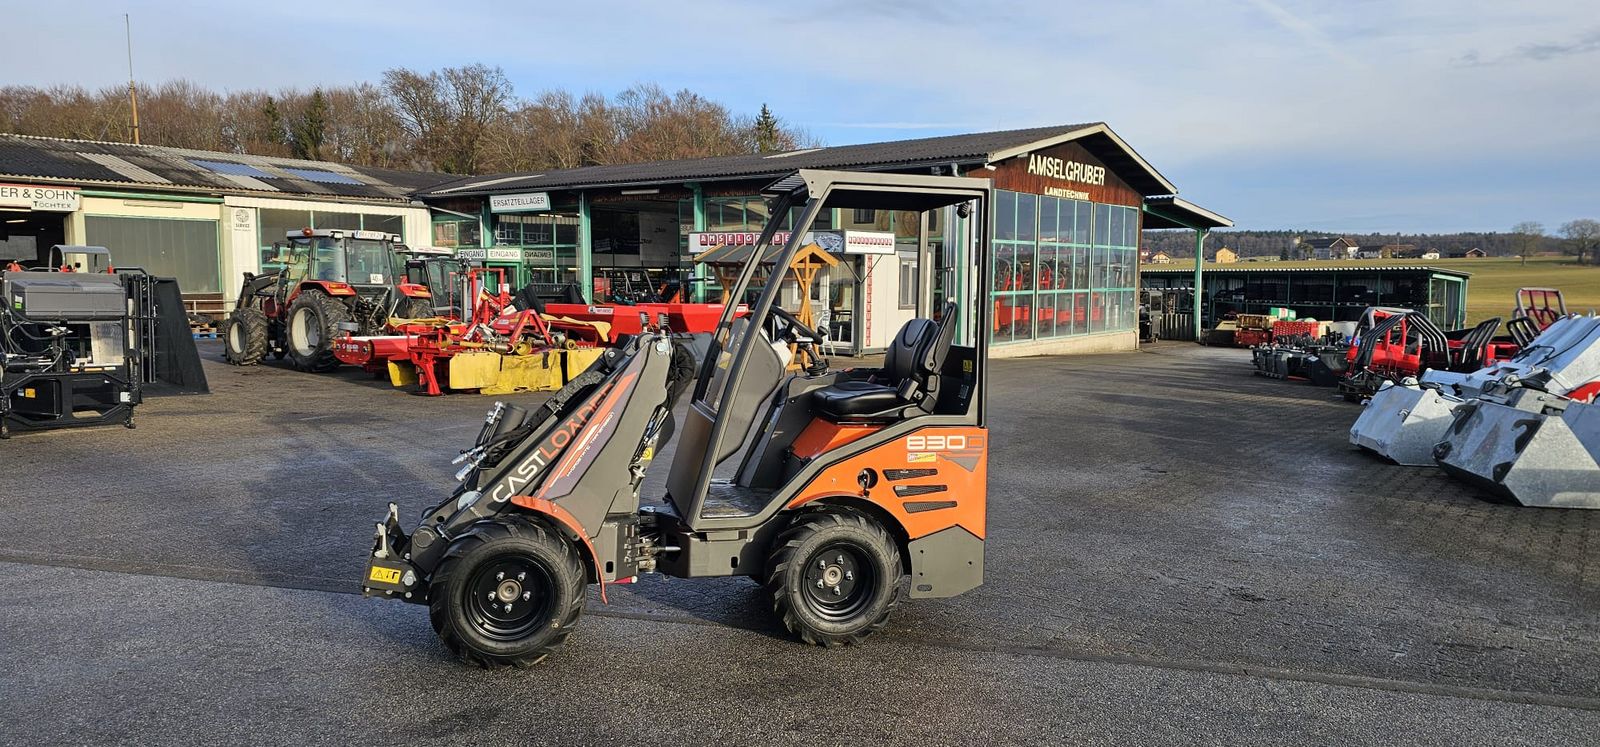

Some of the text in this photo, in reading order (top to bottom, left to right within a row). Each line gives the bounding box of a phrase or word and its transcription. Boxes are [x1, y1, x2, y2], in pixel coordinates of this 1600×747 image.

[1028, 153, 1105, 186] AMSELGRUBER
[1, 187, 76, 200] ER & SOHN
[1044, 186, 1090, 200] LANDTECHNIK
[493, 196, 545, 207] ERSATZTEILLAGER
[460, 250, 484, 258] EINGANG
[489, 250, 518, 258] EINGANG
